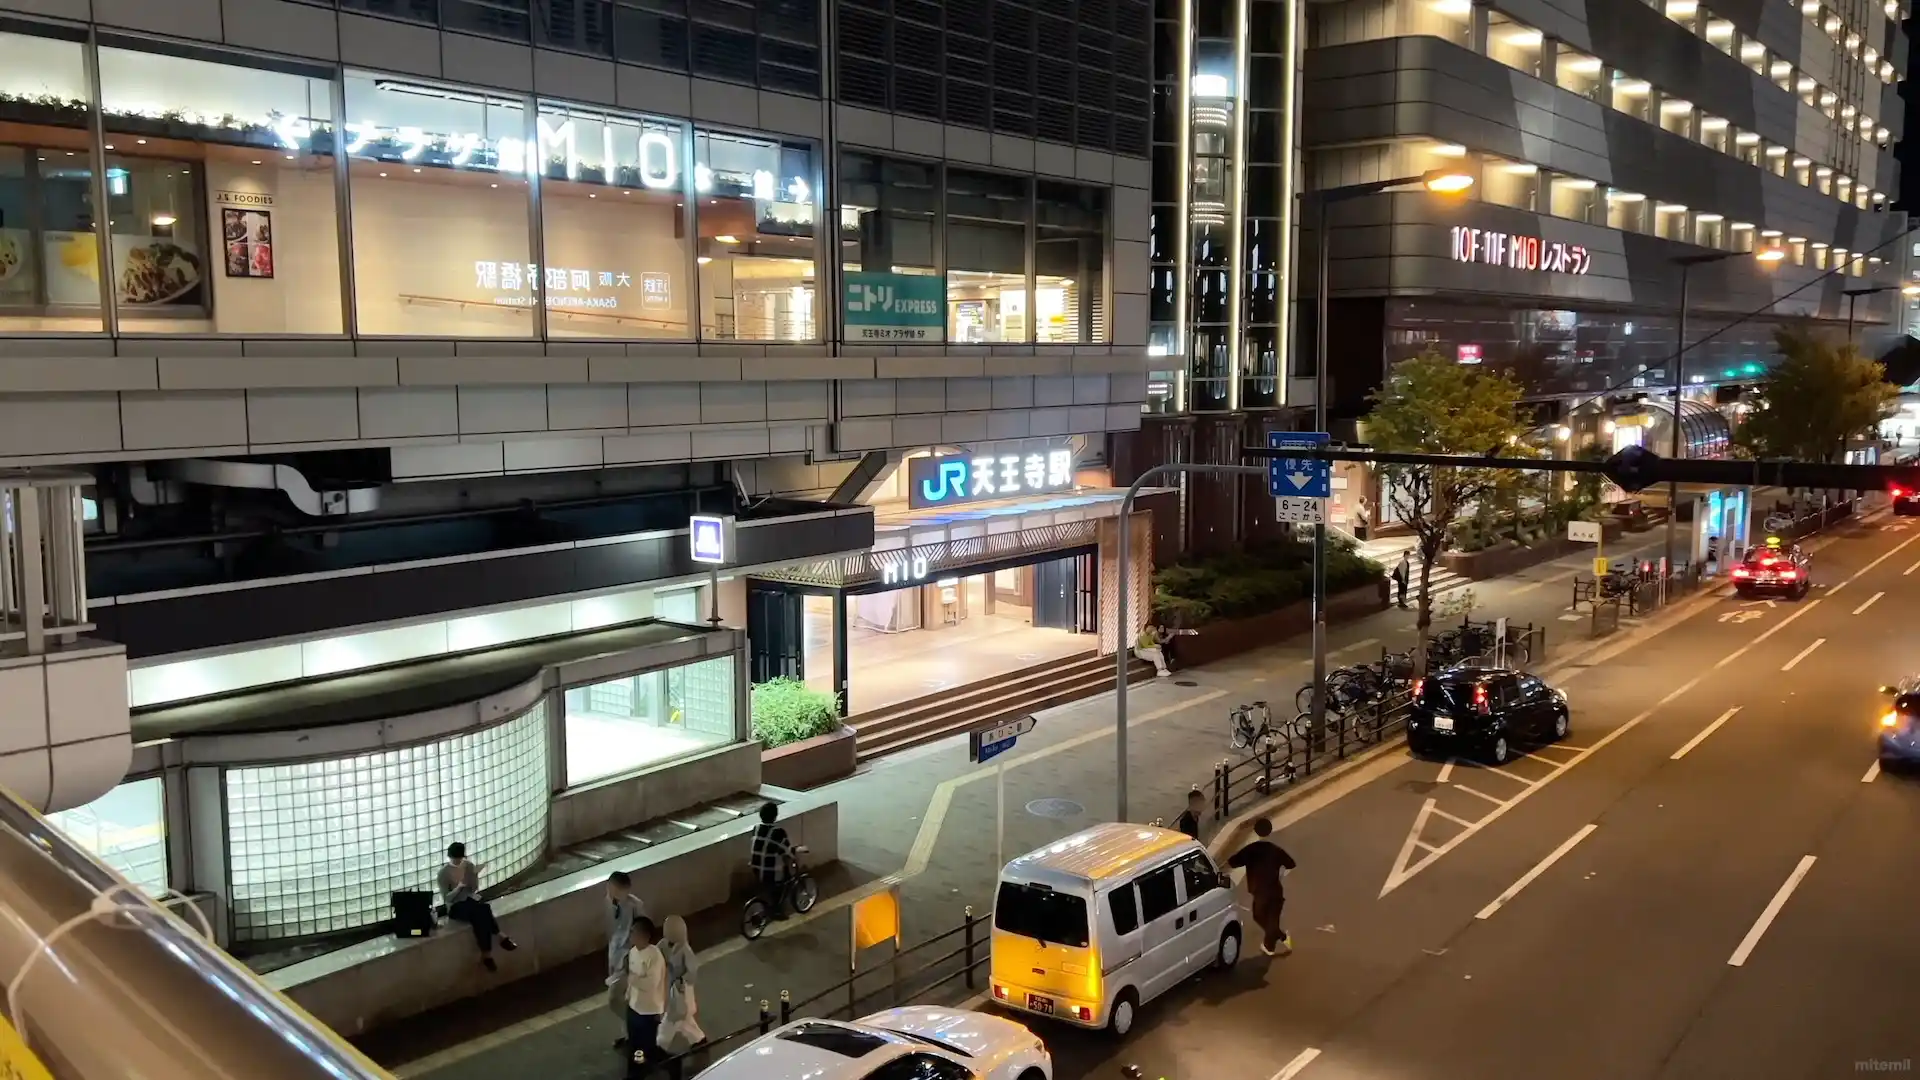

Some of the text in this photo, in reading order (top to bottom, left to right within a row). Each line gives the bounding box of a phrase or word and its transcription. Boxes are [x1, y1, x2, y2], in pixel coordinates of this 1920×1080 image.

[535, 116, 675, 188] MIO
[234, 194, 273, 204] FOODIES
[1508, 235, 1538, 270] MIO
[1541, 240, 1591, 275] レストラン
[848, 284, 894, 313] ニトリ
[895, 300, 937, 314] EXPRESS
[923, 450, 1071, 501] JR 天王寺駅
[1285, 458, 1314, 471] 優先
[1279, 512, 1322, 521] ここから
[884, 556, 927, 584] MIO
